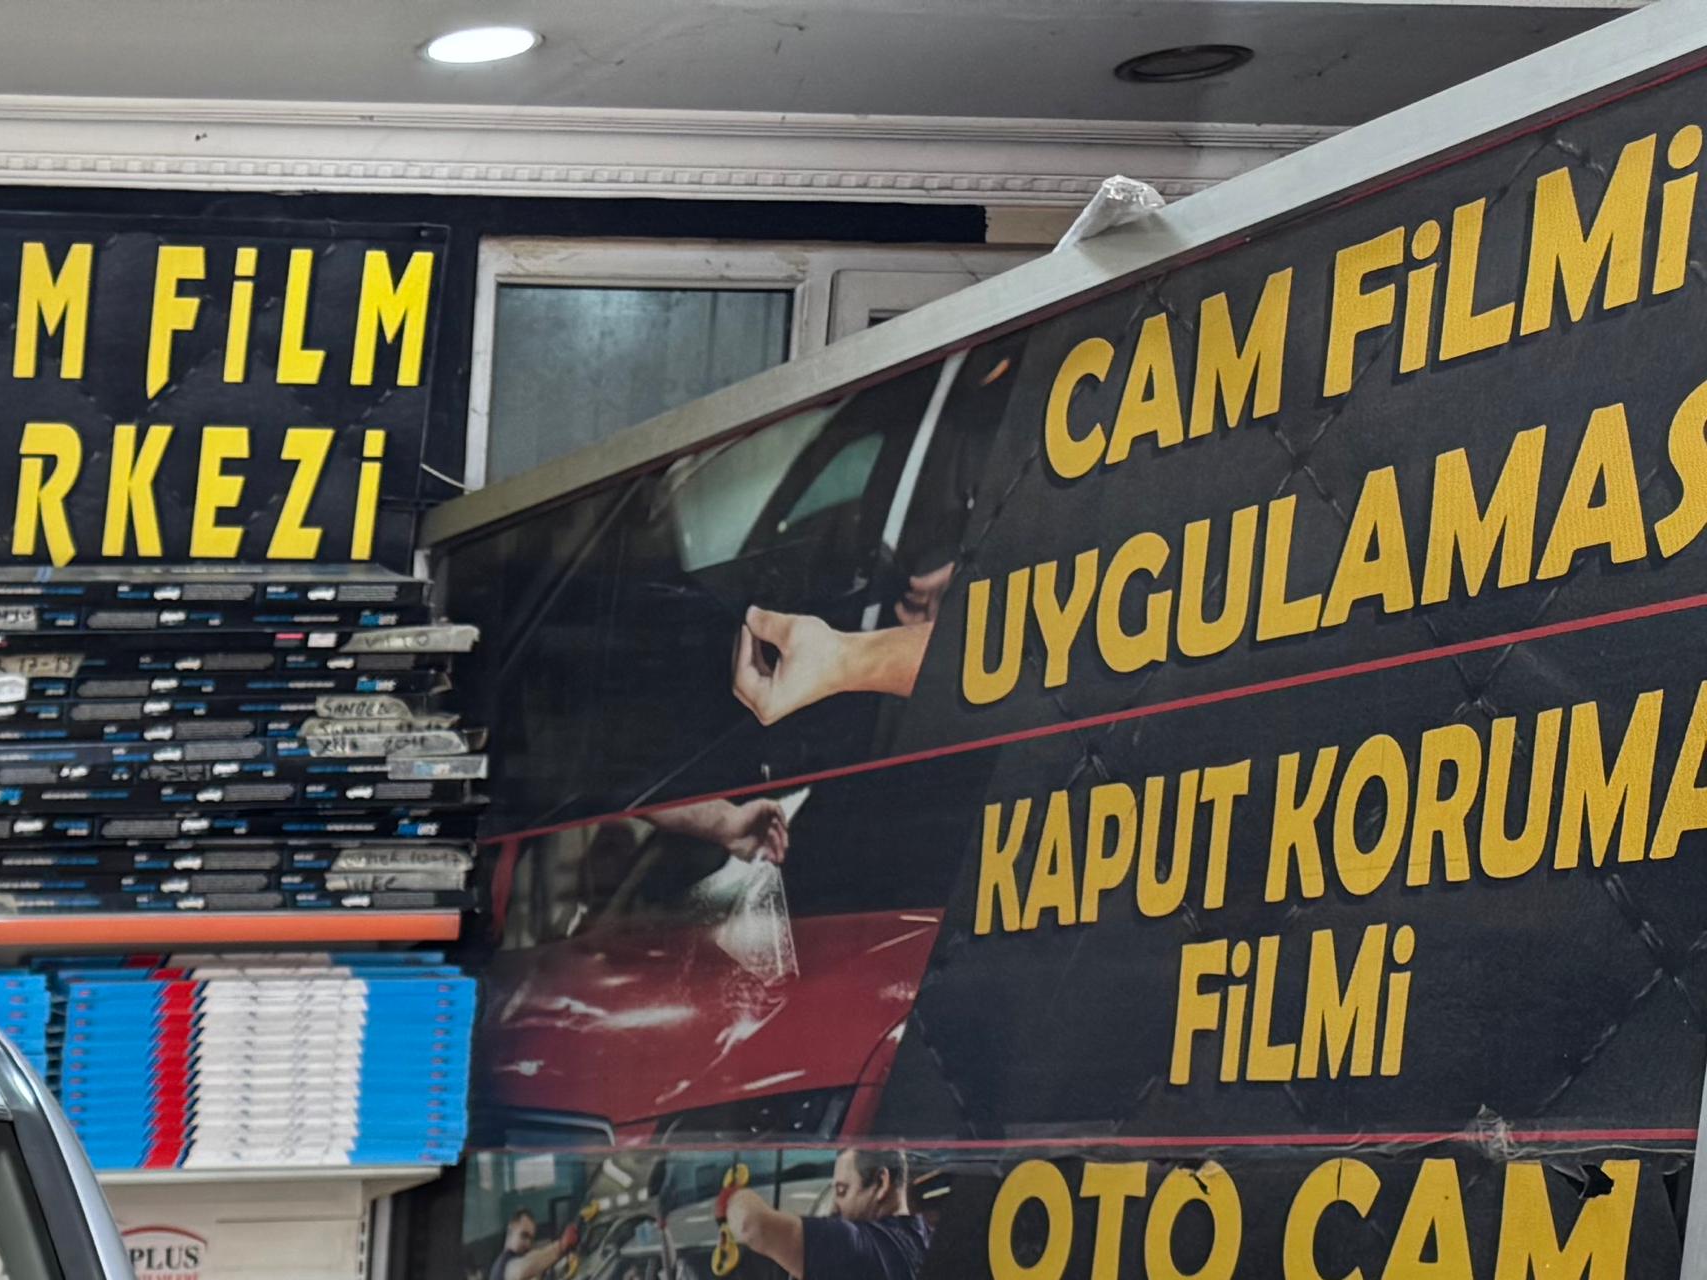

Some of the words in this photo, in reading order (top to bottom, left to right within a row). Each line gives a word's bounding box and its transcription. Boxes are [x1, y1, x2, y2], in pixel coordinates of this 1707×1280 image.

[1047, 266, 1293, 479] CAM
[975, 760, 1251, 936] KAPUT
[1265, 681, 1707, 904] KORUMA
